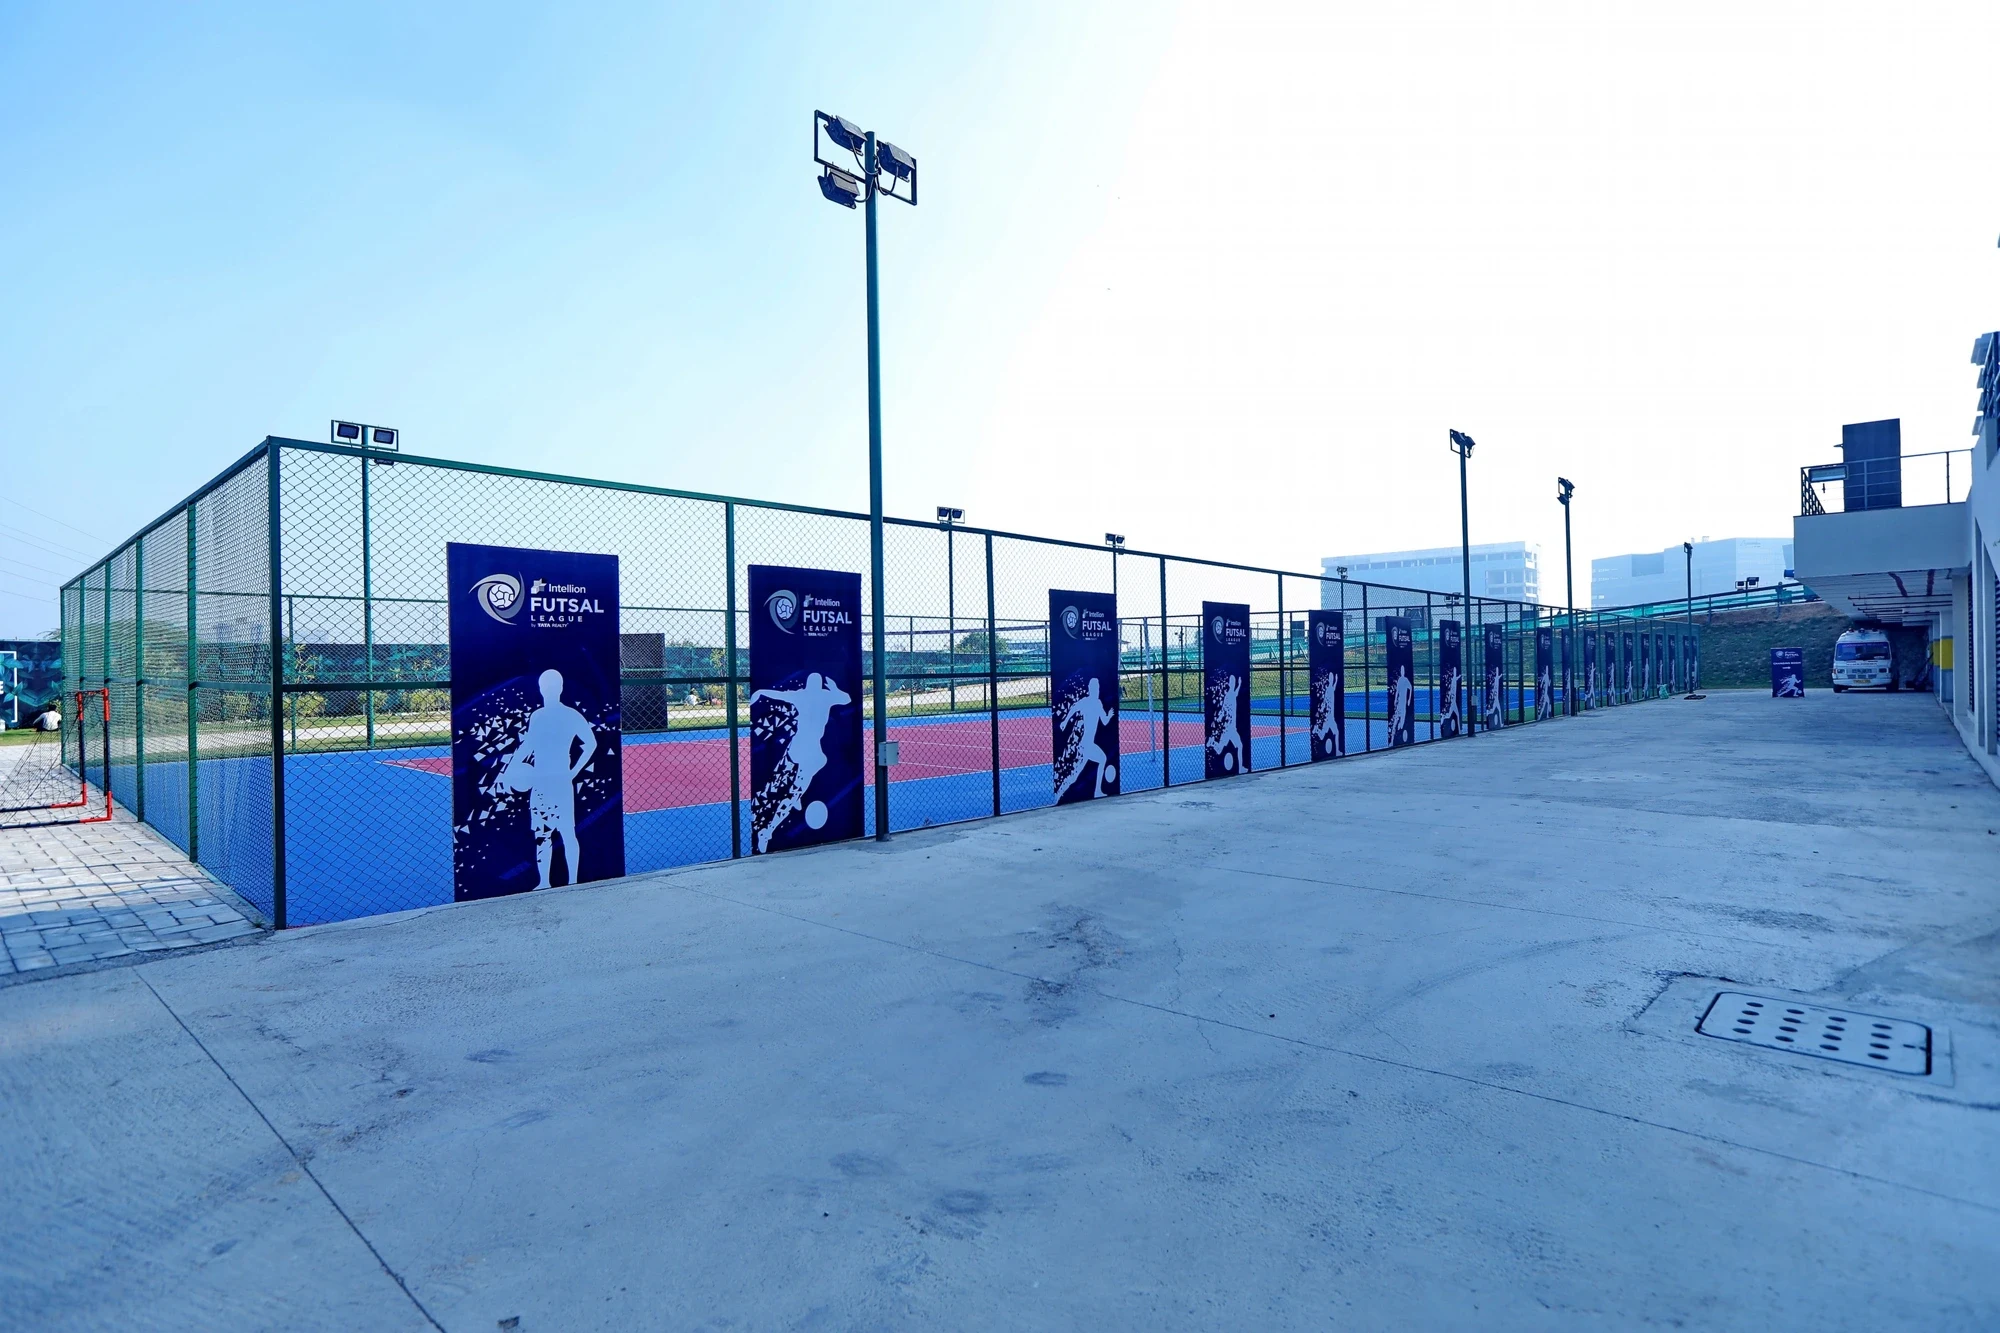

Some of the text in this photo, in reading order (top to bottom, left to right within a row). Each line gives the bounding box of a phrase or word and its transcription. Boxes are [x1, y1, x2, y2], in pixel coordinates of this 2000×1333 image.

[548, 583, 586, 594] Intellion
[530, 597, 605, 613] FUTSAL
[814, 598, 840, 607] Intellion
[530, 614, 583, 622] LEAGUE
[803, 610, 852, 624] FUTSAL
[1082, 620, 1112, 631] FUTSAL
[1226, 628, 1246, 637] FUTSAL
